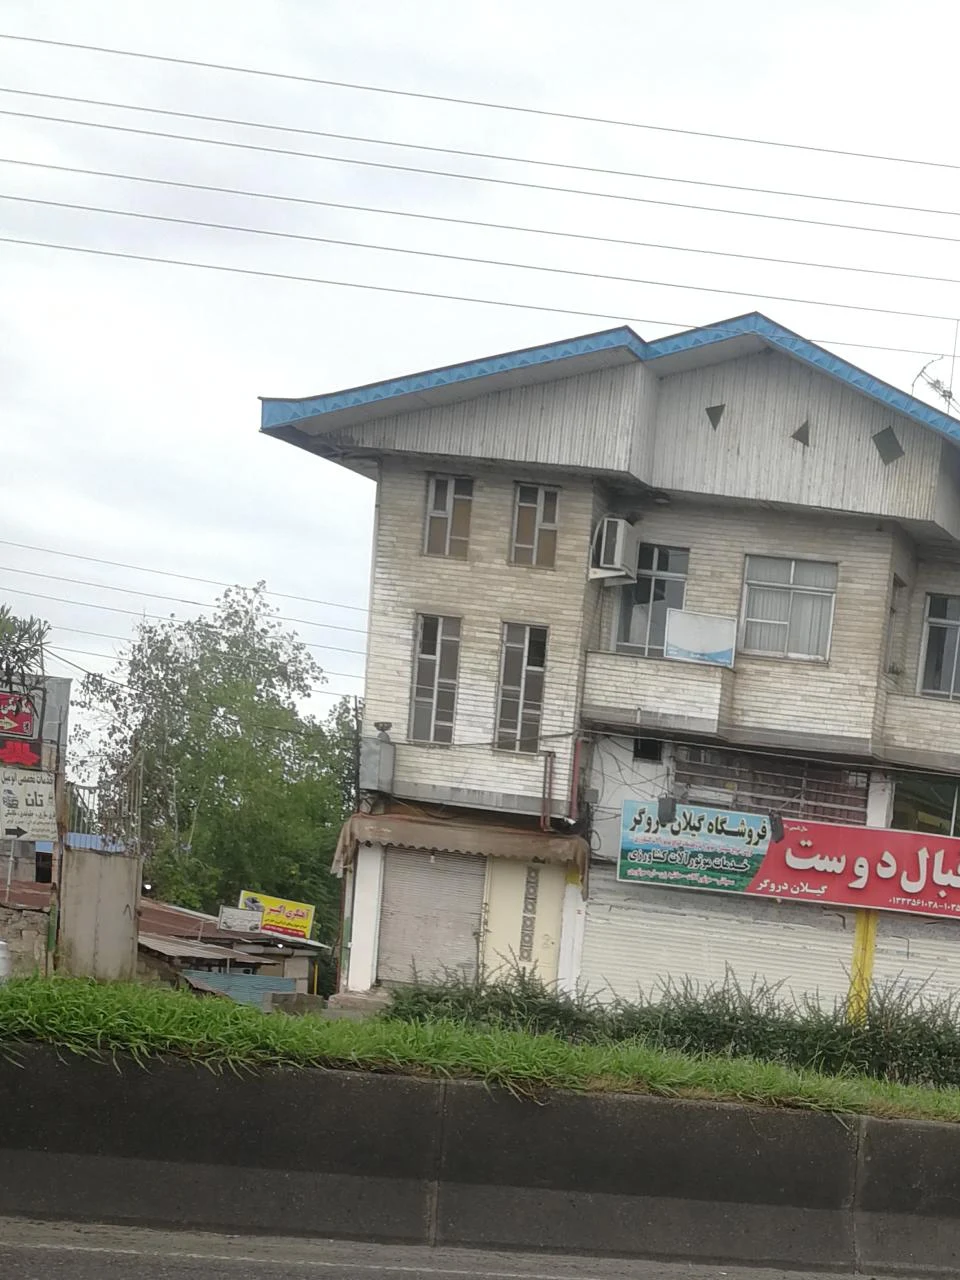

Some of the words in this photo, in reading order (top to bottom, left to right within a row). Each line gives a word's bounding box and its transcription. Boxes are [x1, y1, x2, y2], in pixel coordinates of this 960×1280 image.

[670, 809, 705, 837] گیلان
[707, 815, 769, 846] فروشگاه
[627, 847, 668, 865] کشاورزی
[713, 855, 751, 872] خدمات
[755, 878, 789, 895] دروگر
[790, 882, 828, 898] گیلان
